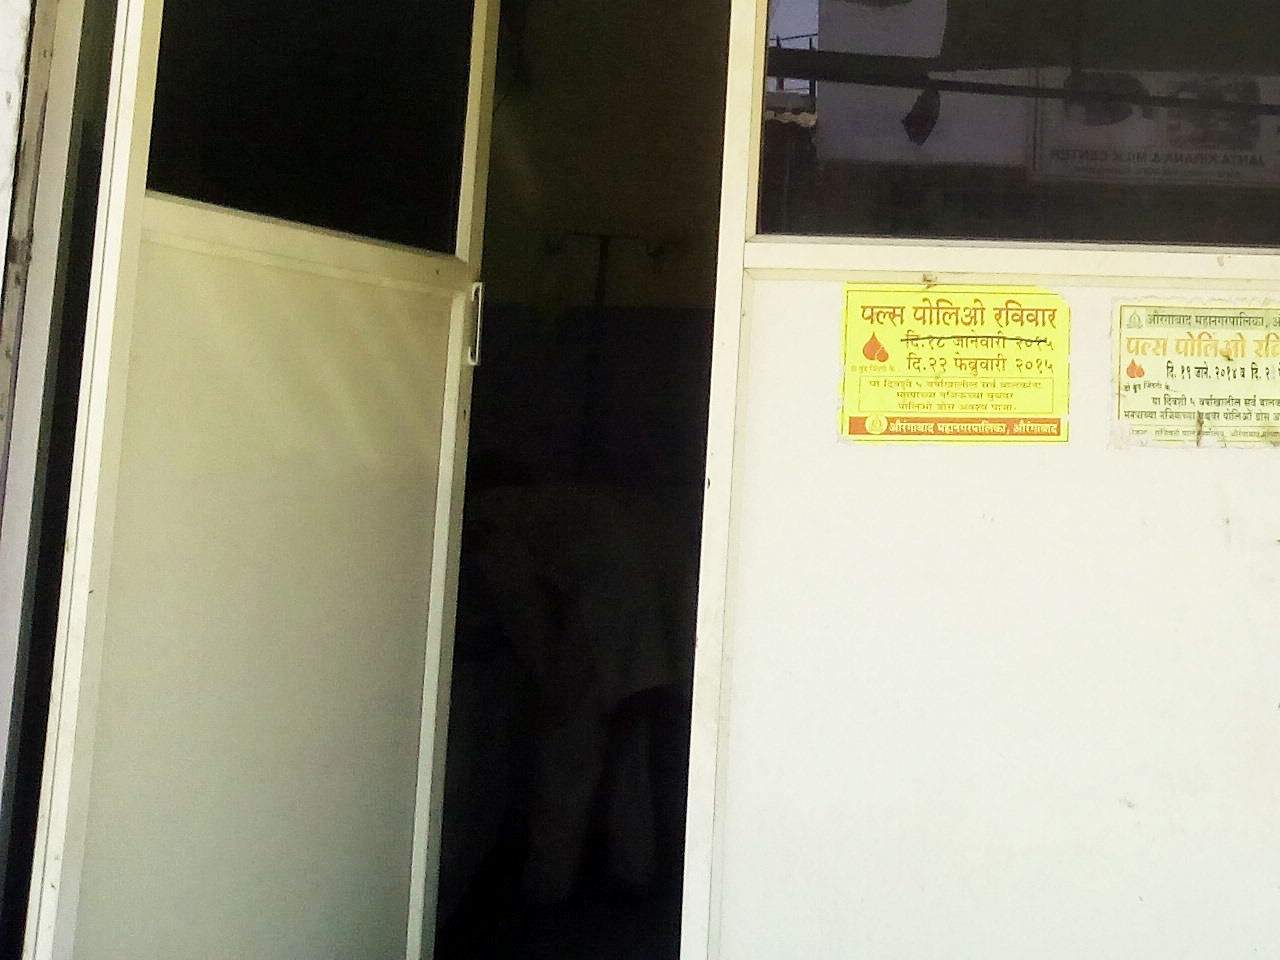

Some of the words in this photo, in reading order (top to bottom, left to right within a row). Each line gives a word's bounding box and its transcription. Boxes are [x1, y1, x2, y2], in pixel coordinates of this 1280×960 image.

[860, 304, 906, 327] पल्स
[912, 297, 986, 326] पोलिओ
[993, 299, 1058, 329] रविवार
